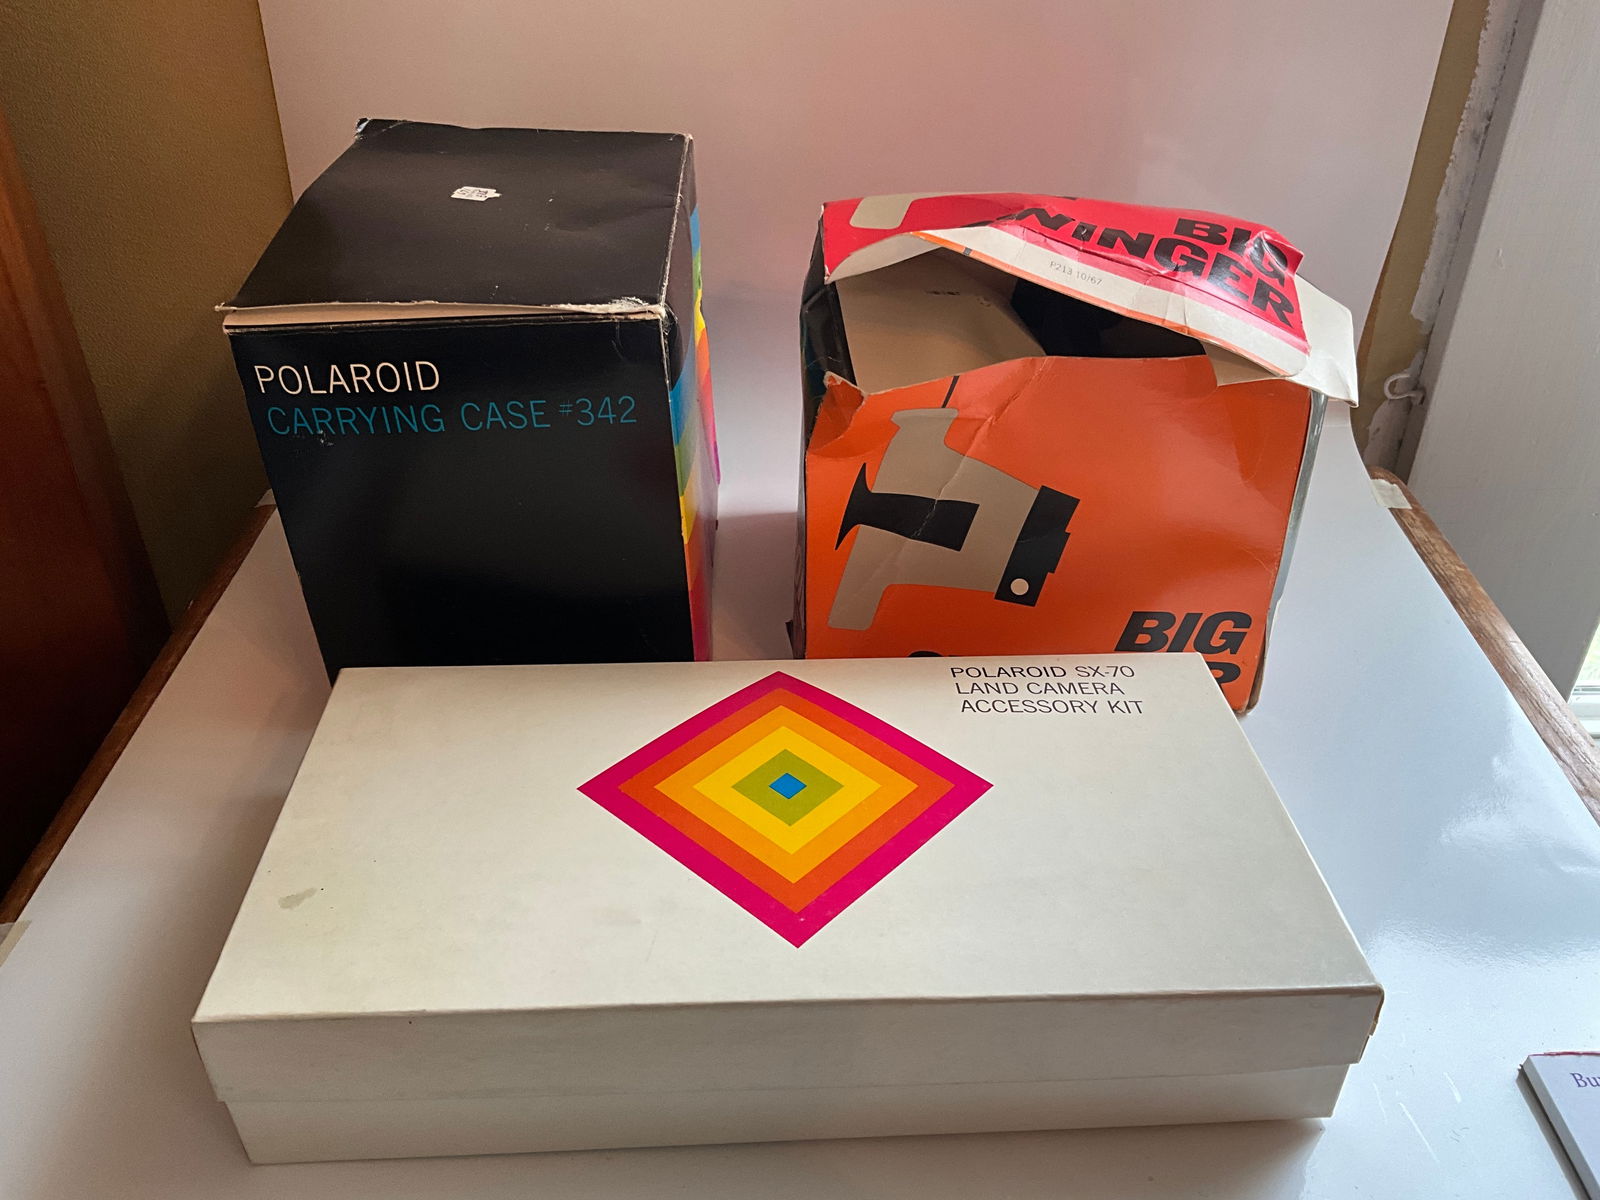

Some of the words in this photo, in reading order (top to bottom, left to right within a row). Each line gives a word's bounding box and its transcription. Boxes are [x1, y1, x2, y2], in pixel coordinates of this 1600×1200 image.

[1173, 217, 1289, 288] BIG
[1076, 270, 1103, 286] 10/67
[253, 360, 440, 395] POLAROID
[267, 403, 446, 436] CARRYING
[459, 399, 551, 431] CASE
[558, 395, 637, 425] #342
[1113, 610, 1253, 655] BIG
[950, 665, 1067, 678] POLAROID
[1074, 665, 1136, 678] SX-70
[955, 682, 1019, 695] LAND
[1026, 682, 1126, 696] CAMERA
[961, 699, 1099, 714] ACCESSORY
[1107, 700, 1143, 714] KIT
[1569, 1072, 1600, 1088] Bu
